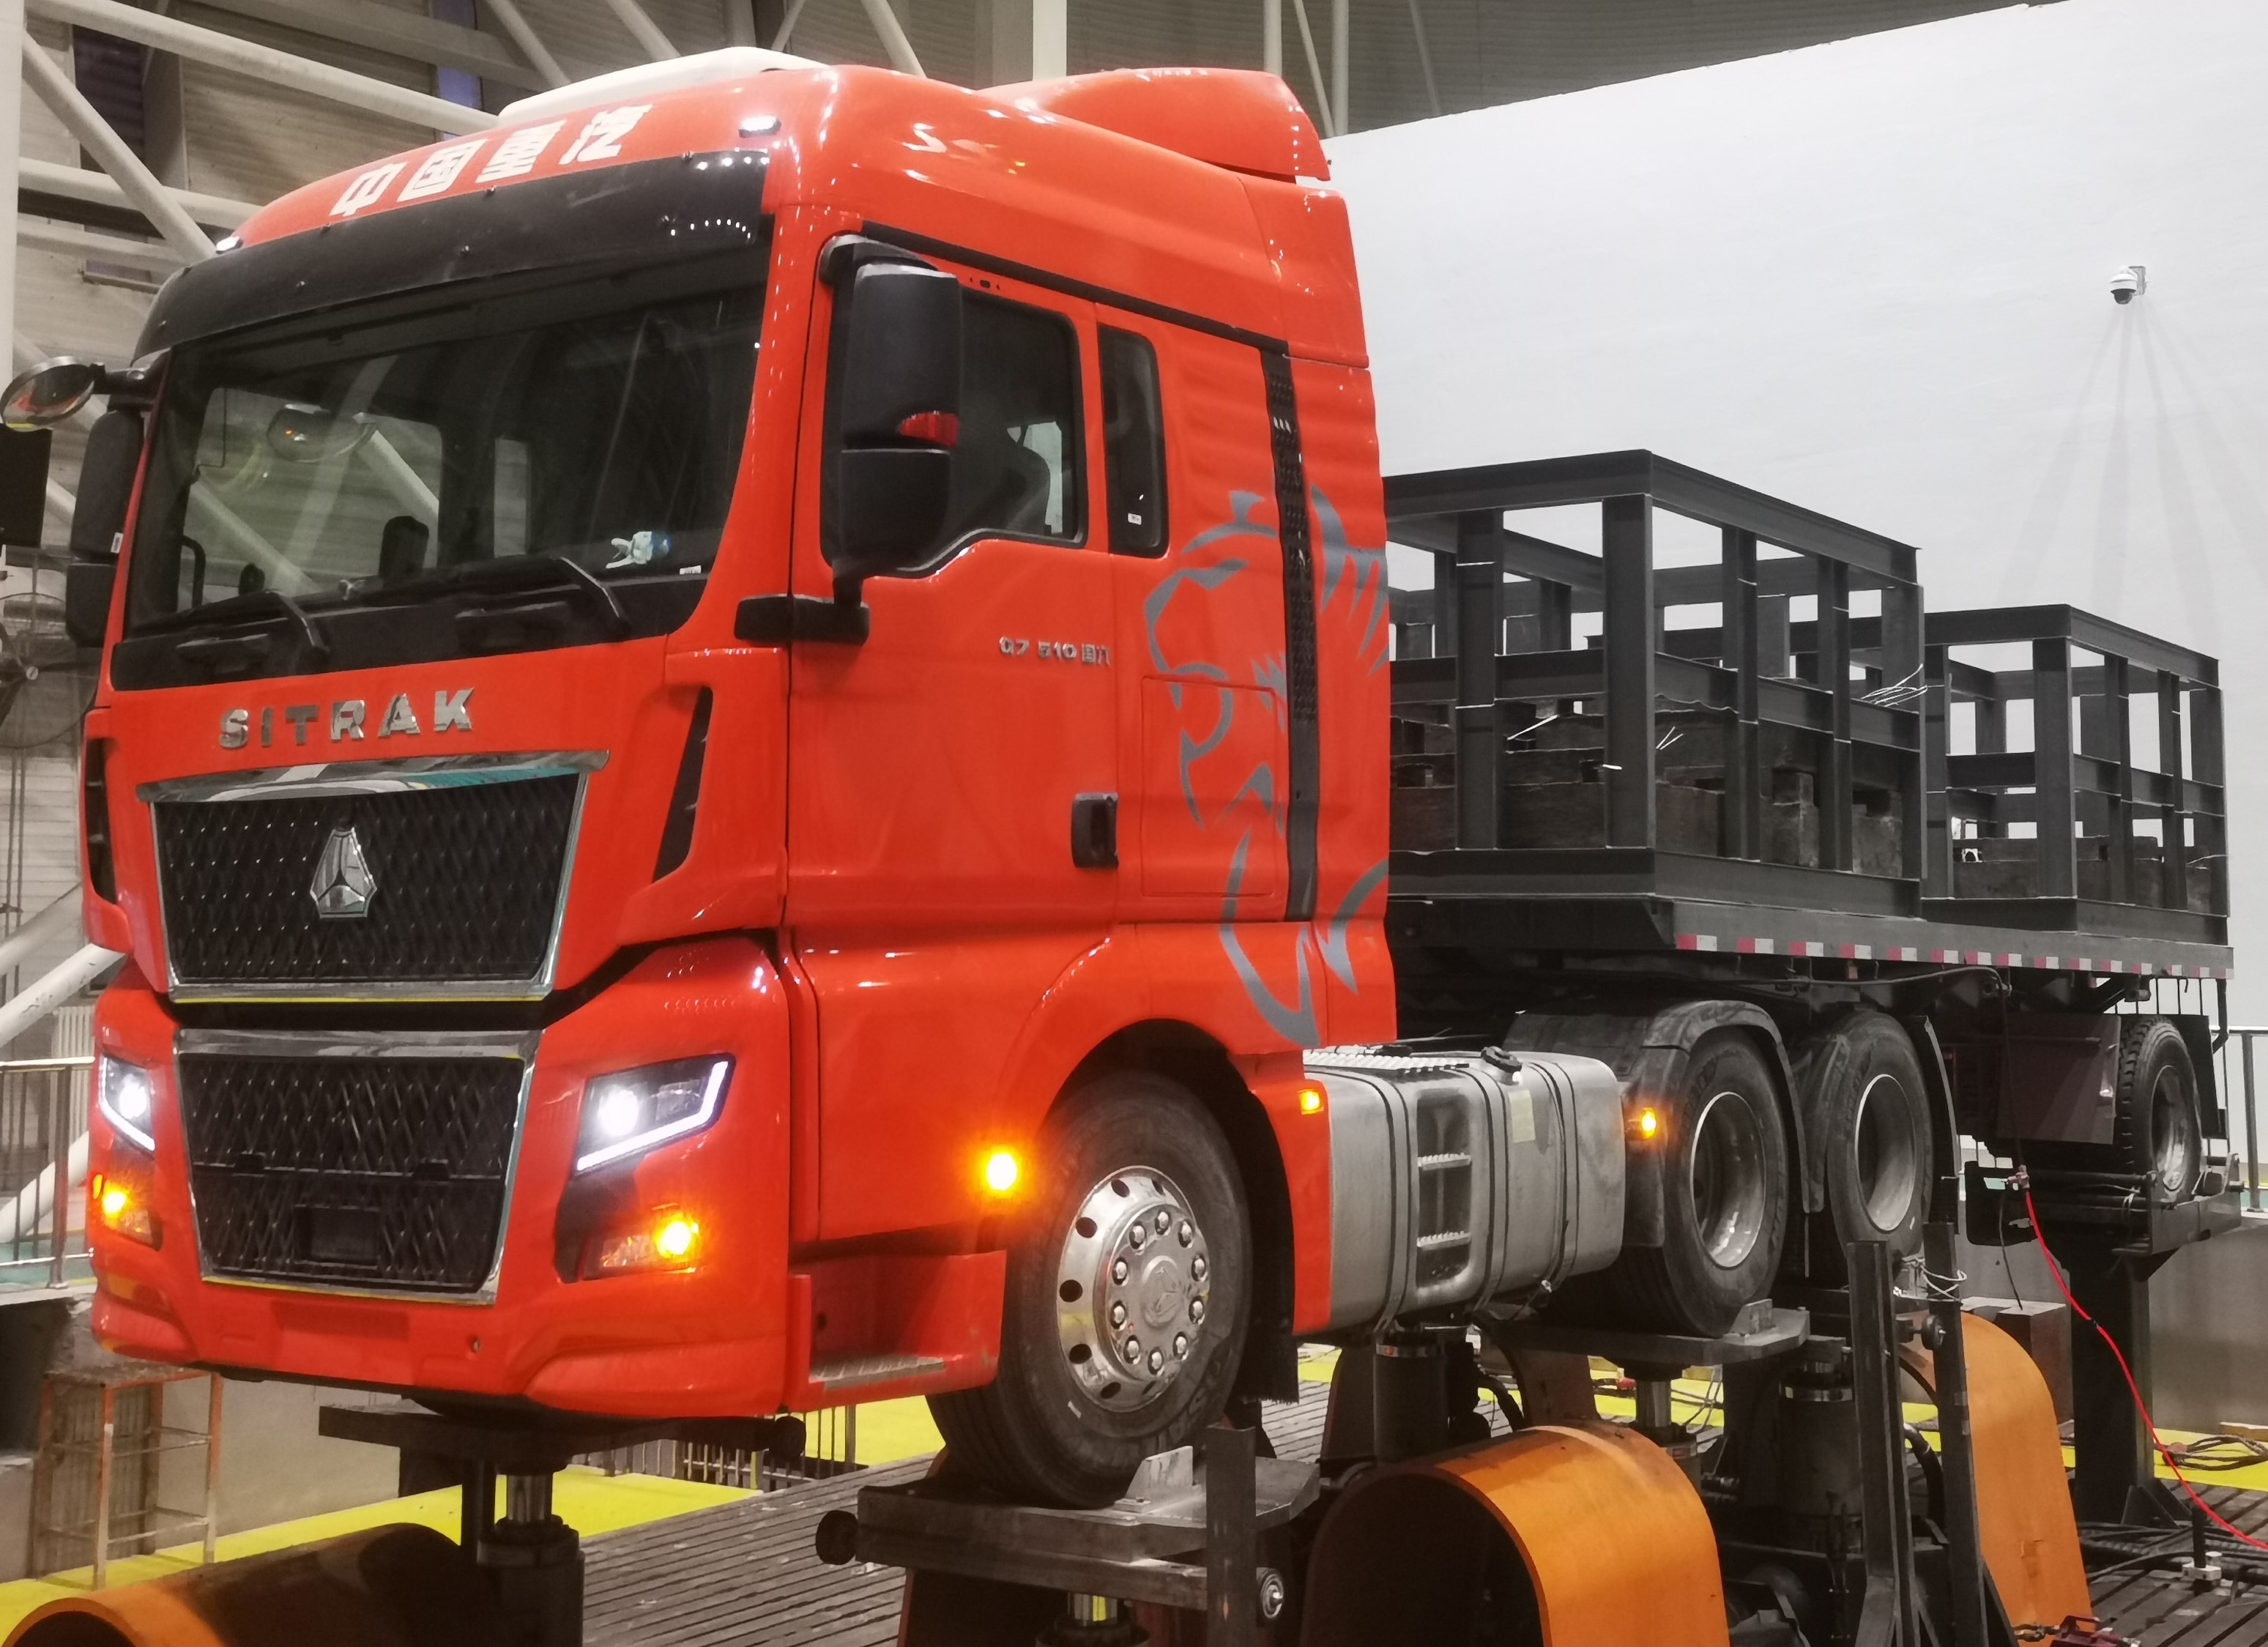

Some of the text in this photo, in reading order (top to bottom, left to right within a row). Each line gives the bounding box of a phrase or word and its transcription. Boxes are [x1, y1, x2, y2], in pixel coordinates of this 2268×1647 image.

[329, 104, 653, 217] 中国重汽
[1038, 640, 1078, 661] 510
[219, 687, 475, 748] SITRAK
